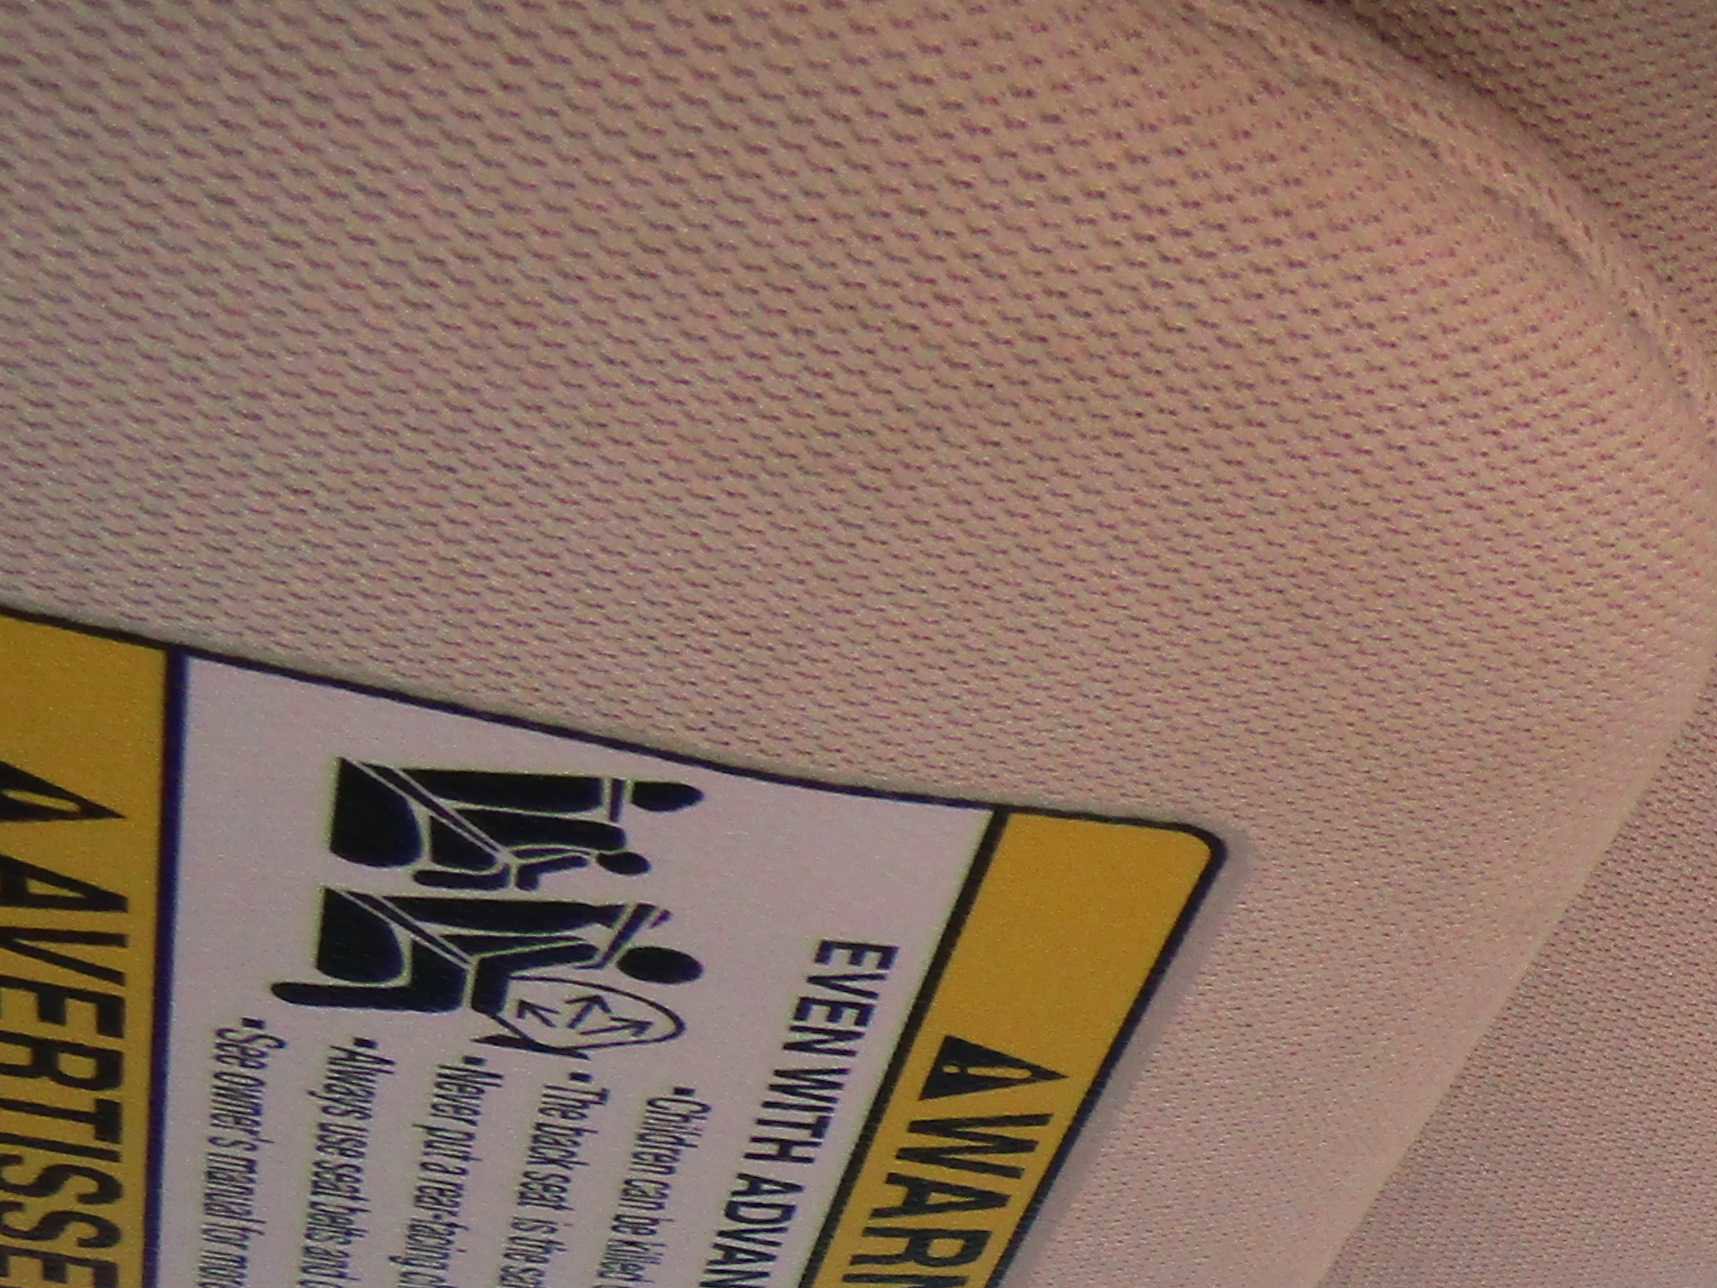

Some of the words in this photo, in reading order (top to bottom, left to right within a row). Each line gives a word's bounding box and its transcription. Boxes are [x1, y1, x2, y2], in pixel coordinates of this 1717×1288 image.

[780, 938, 900, 1058] EVEN
[211, 1027, 288, 1071] See
[306, 1044, 397, 1121] Always
[427, 1063, 505, 1127] Never
[536, 1083, 611, 1121] The
[206, 1070, 275, 1153] owner's
[742, 1067, 852, 1165] WITH
[313, 1121, 370, 1160] use
[411, 1123, 482, 1163] put
[525, 1121, 599, 1171] back
[628, 1096, 713, 1176] Children
[202, 1151, 267, 1225] manual
[309, 1158, 370, 1203] seat
[418, 1161, 470, 1177] a
[515, 1170, 574, 1212] seat
[617, 1177, 672, 1212] can
[199, 1221, 266, 1251] for
[302, 1200, 372, 1246] belts
[386, 1176, 470, 1272] rear-facing
[509, 1216, 572, 1235] is
[609, 1213, 674, 1237] be
[298, 1244, 360, 1282] and
[501, 1235, 568, 1265] the
[596, 1237, 667, 1283] killed
